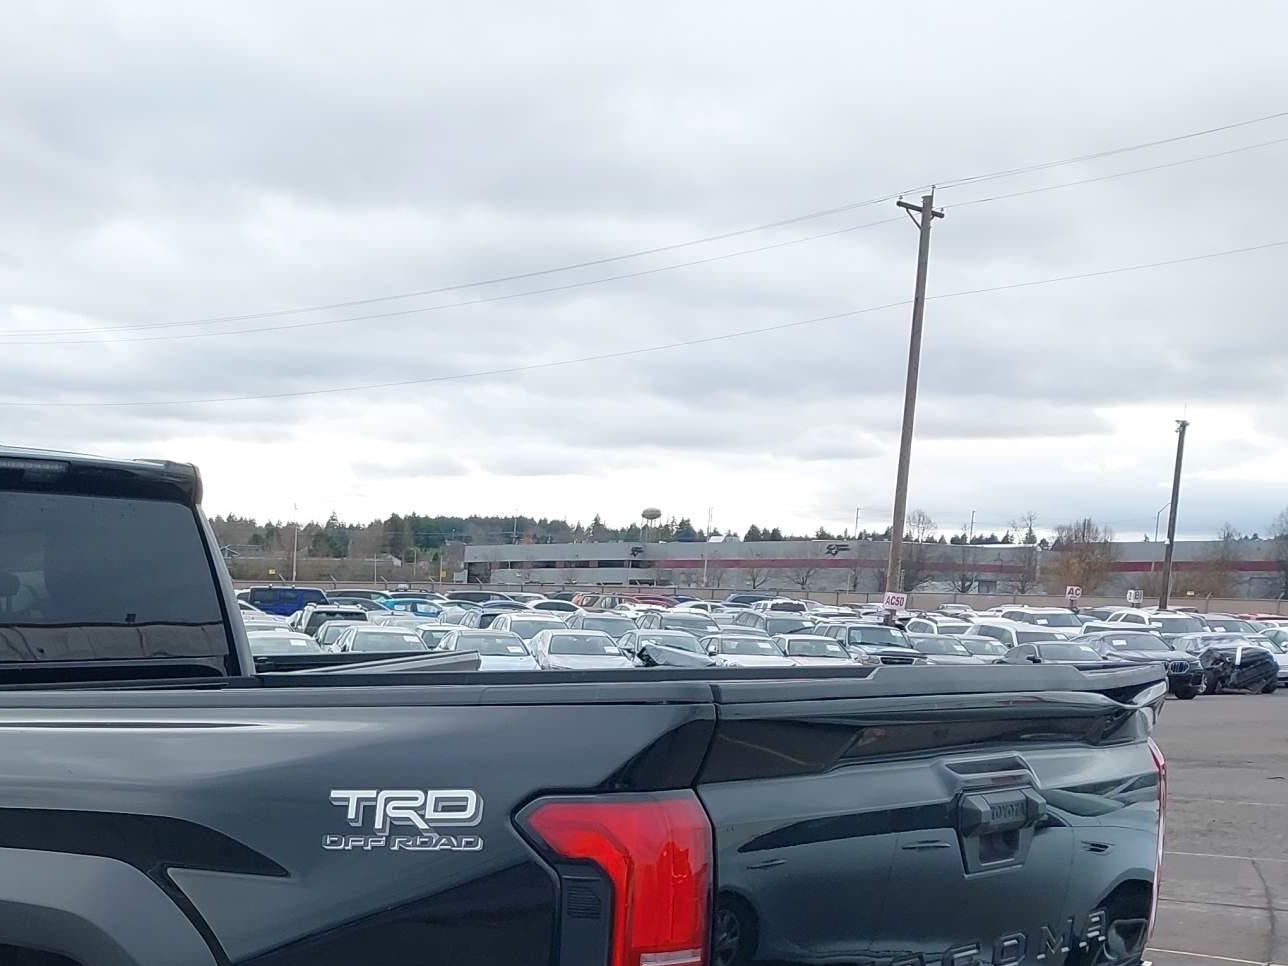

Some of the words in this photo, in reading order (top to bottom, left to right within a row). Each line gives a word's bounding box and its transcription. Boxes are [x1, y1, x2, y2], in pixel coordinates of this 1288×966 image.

[328, 788, 484, 837] TRD
[321, 834, 386, 851] OFF
[389, 834, 484, 851] ROAD
